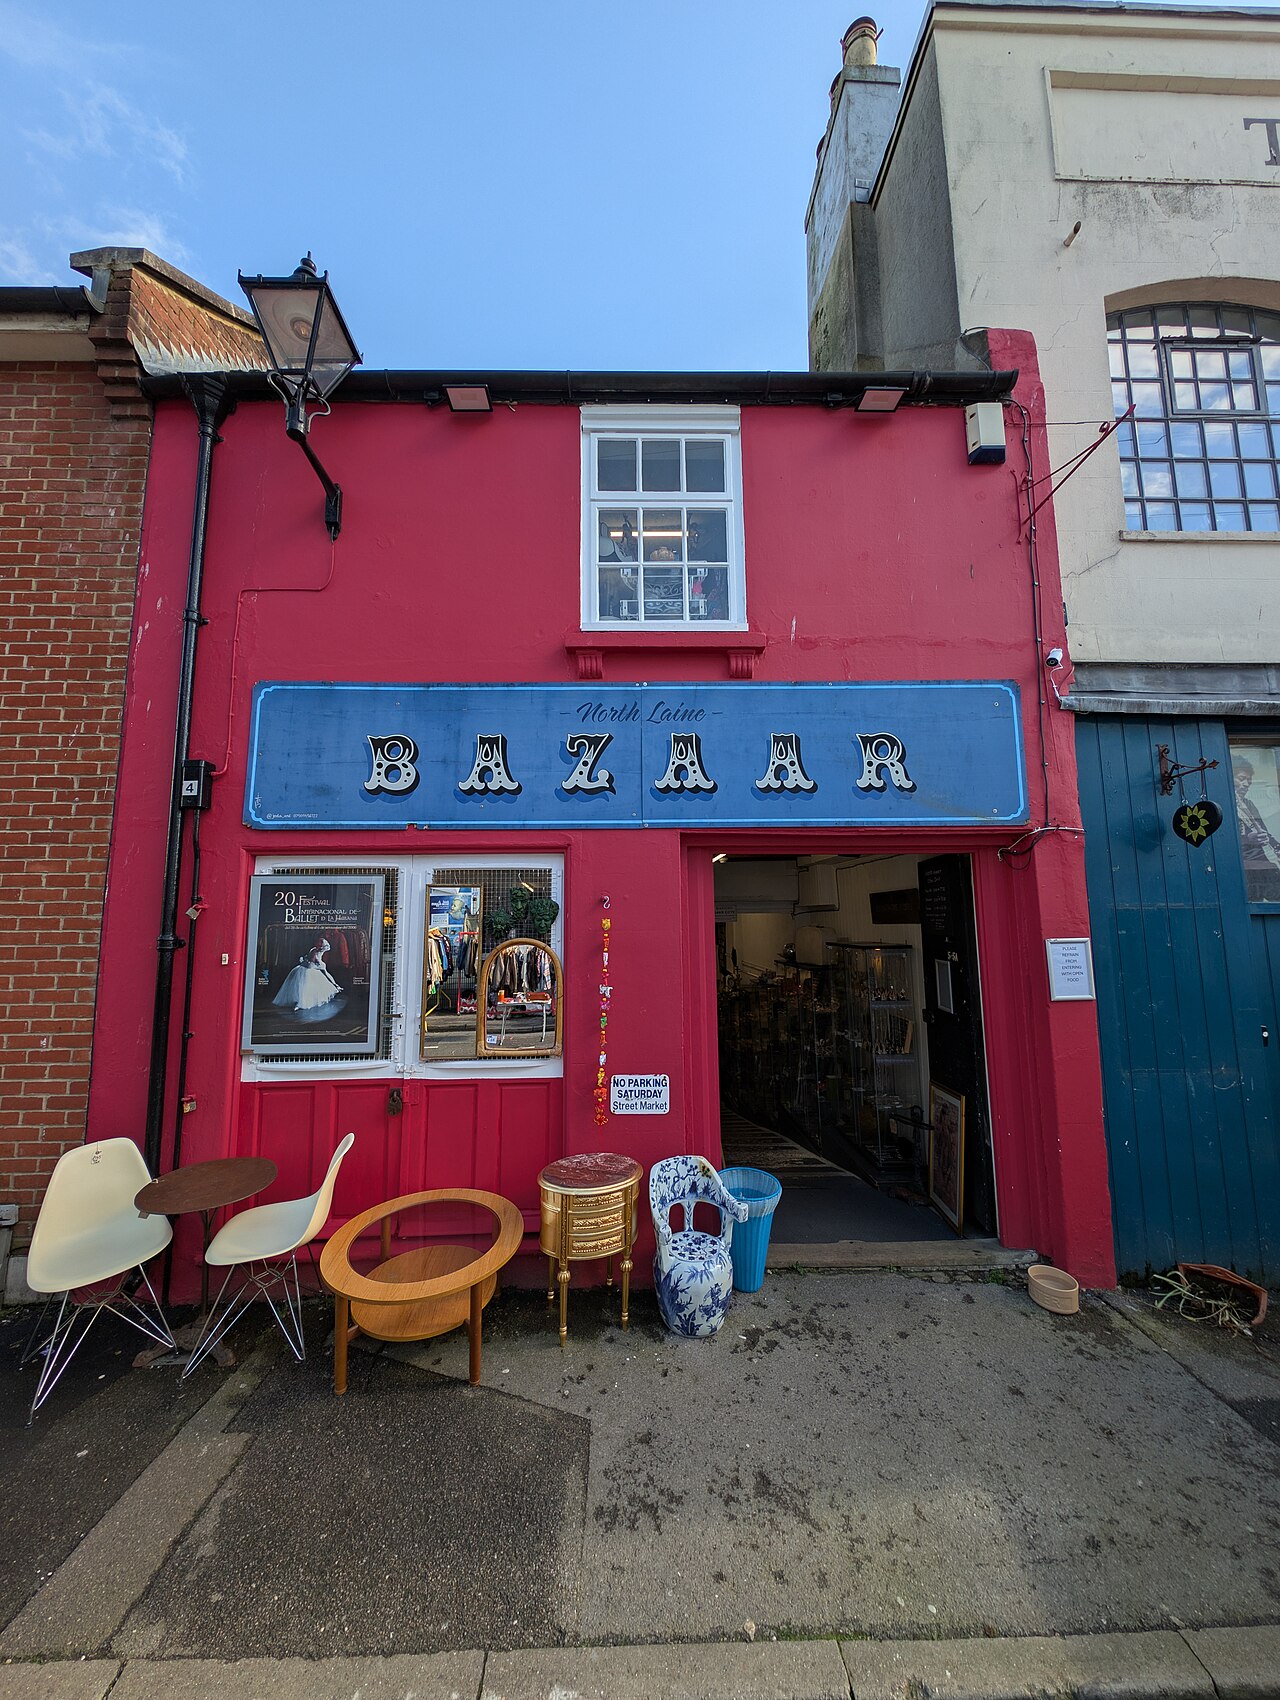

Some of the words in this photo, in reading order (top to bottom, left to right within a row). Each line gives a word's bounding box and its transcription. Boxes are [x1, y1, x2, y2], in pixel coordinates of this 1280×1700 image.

[577, 701, 640, 723] North
[646, 701, 706, 724] Laine
[363, 732, 918, 796] BAZAAR
[186, 783, 193, 793] 4
[613, 1078, 626, 1088] NO
[628, 1078, 668, 1088] PARKING
[617, 1089, 663, 1099] SATURDAY
[612, 1100, 639, 1111] Street
[640, 1100, 668, 1111] Market
